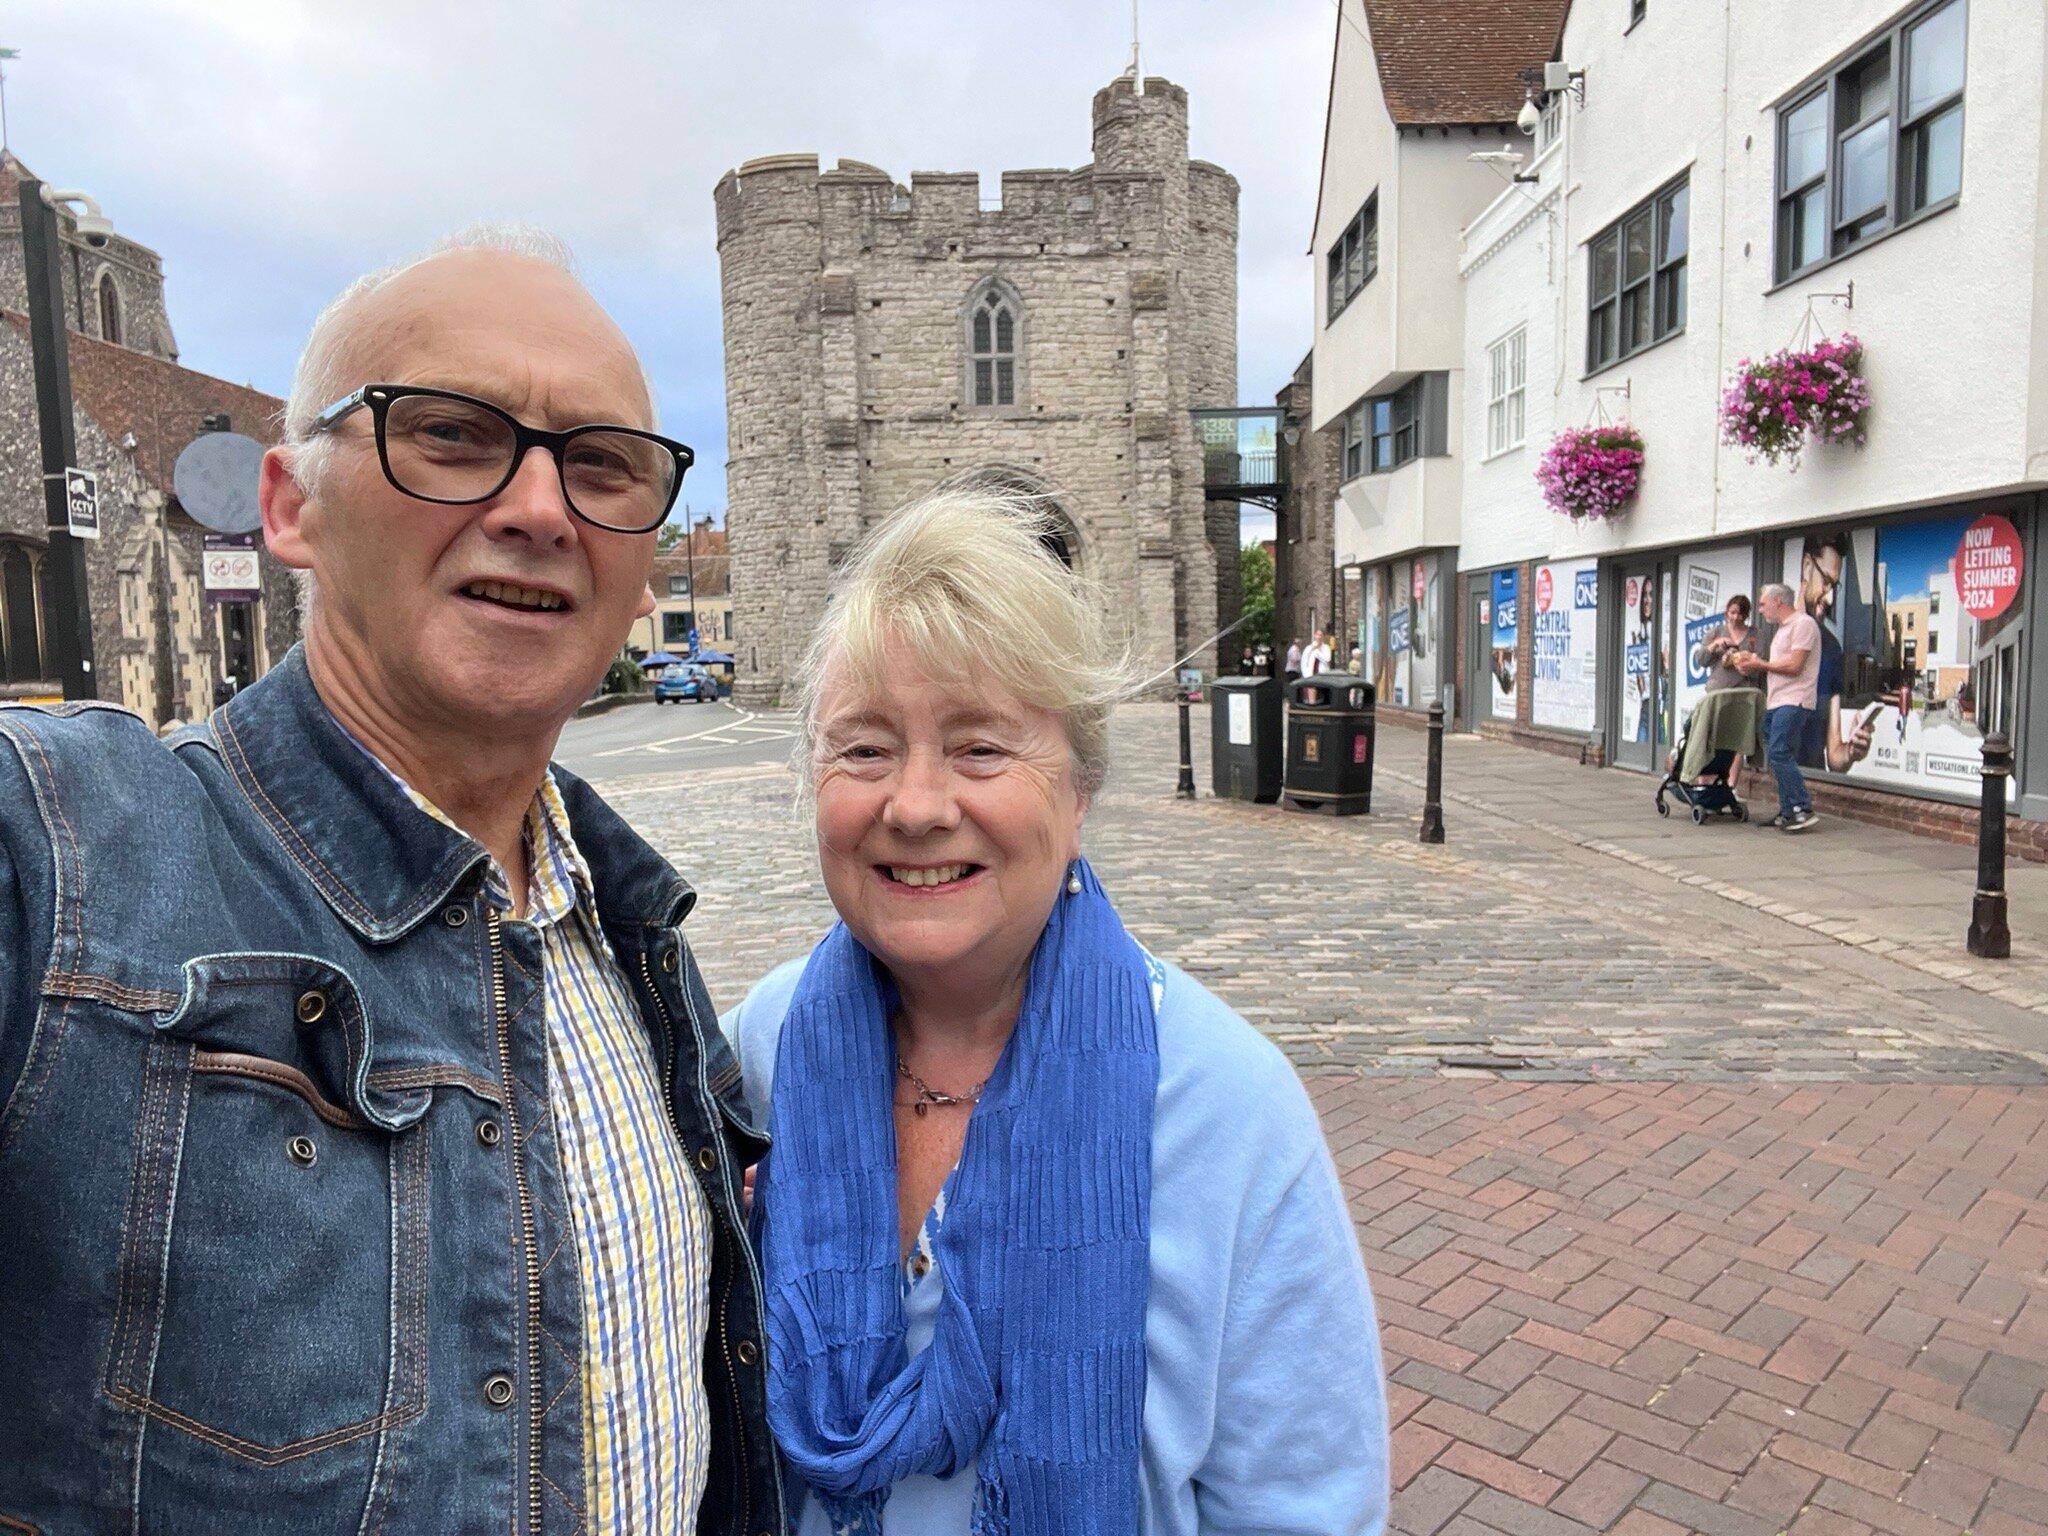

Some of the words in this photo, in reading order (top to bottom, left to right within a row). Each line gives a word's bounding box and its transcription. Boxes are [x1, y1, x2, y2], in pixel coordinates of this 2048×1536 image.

[72, 499, 94, 514] CCTV
[1965, 527, 1994, 549] NOW
[1964, 545, 2012, 569] LETTING
[1963, 566, 2017, 589] SUMMER
[1963, 588, 1995, 609] 2024
[1533, 634, 1570, 657] STUDENT
[1627, 652, 1648, 672] ONE
